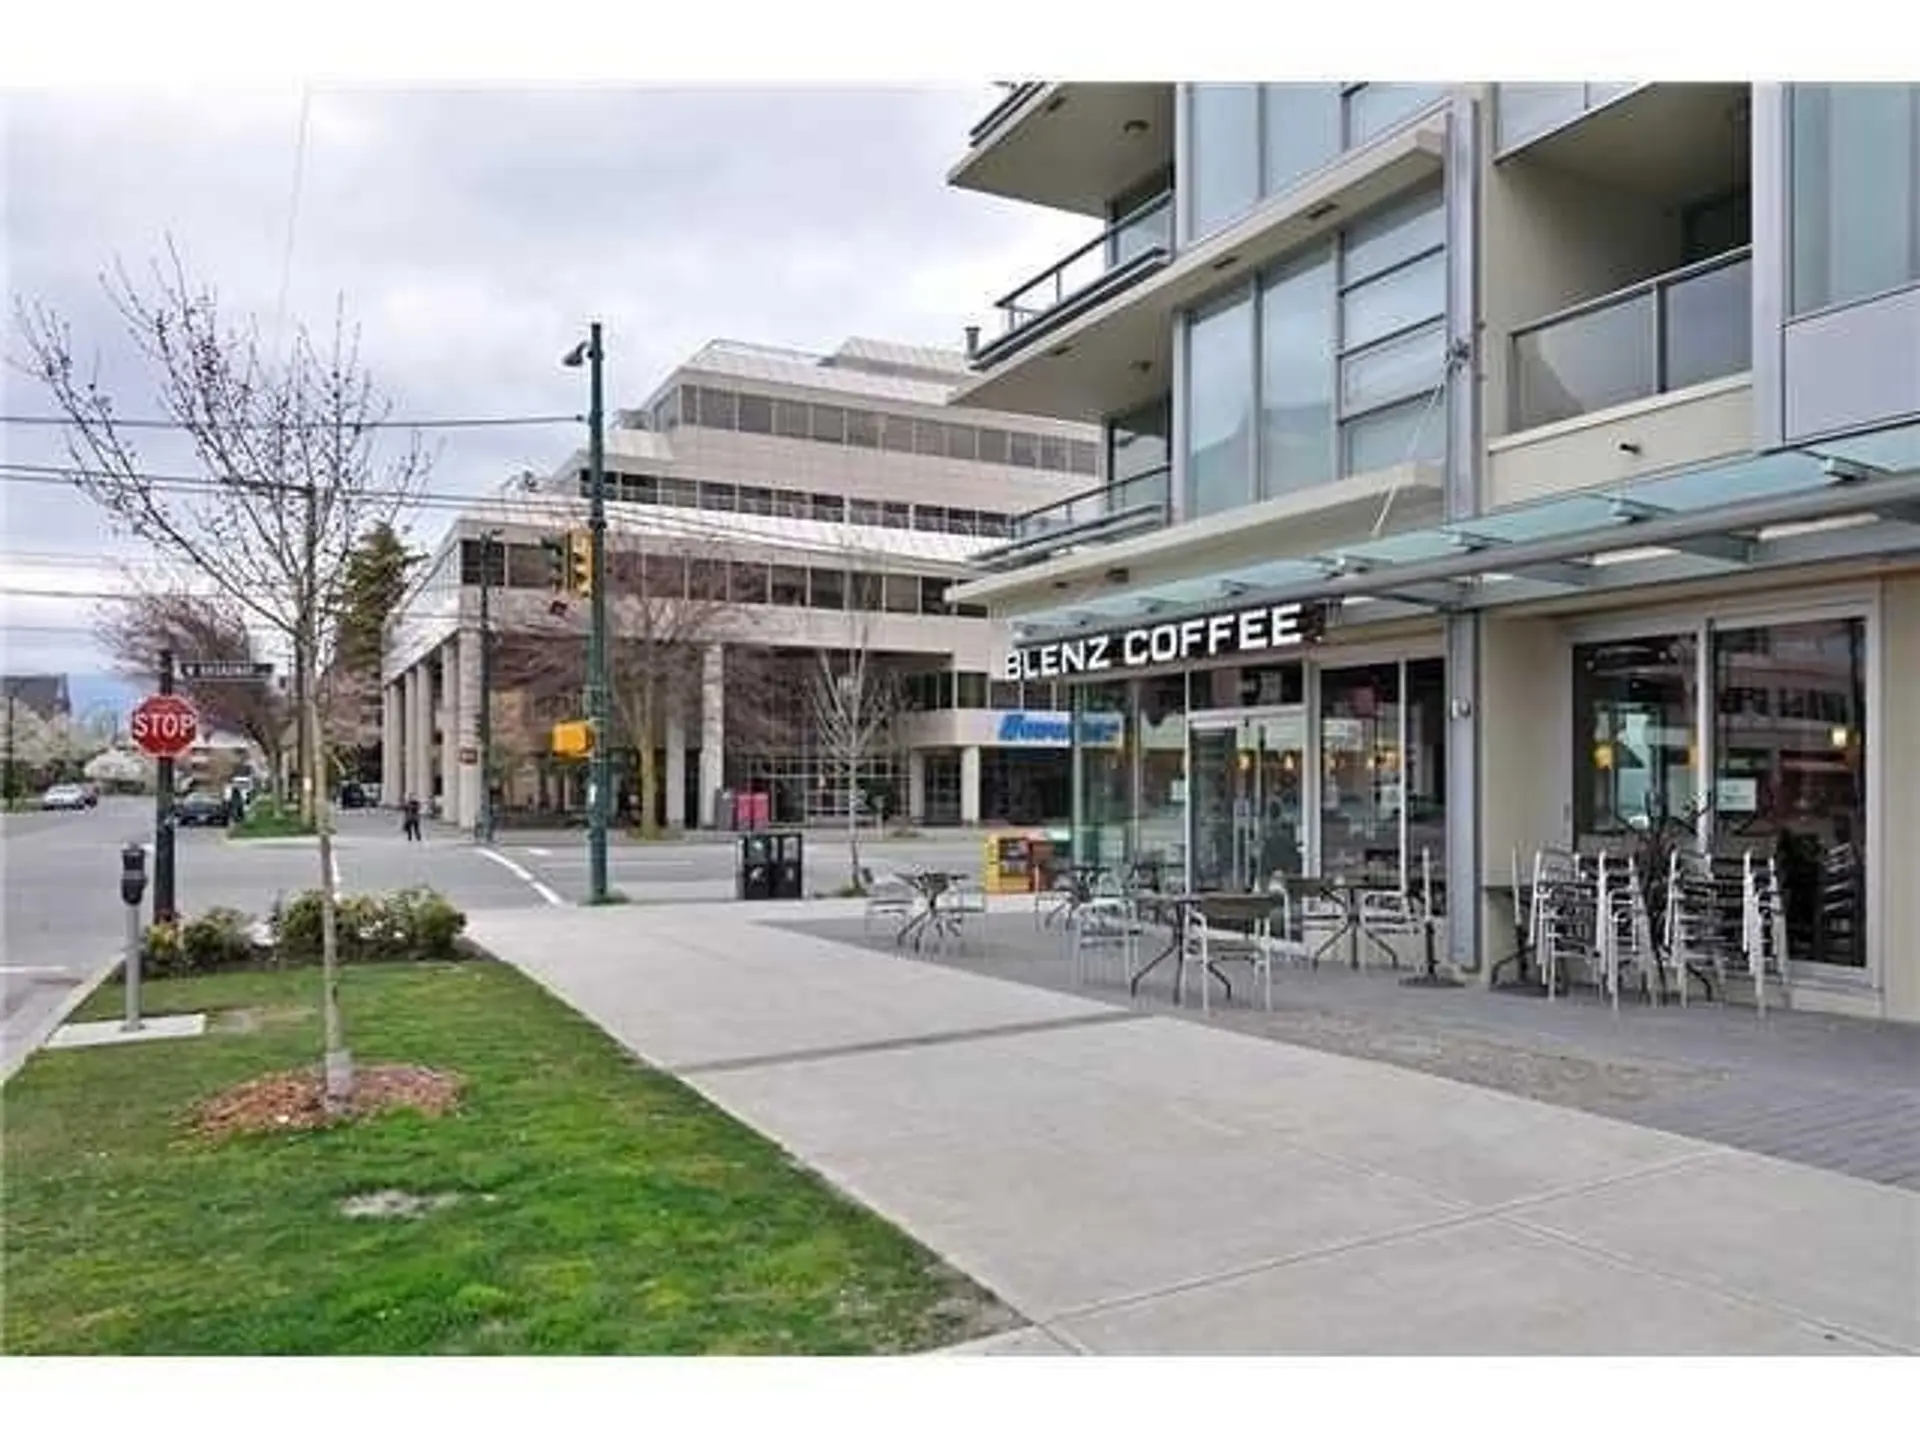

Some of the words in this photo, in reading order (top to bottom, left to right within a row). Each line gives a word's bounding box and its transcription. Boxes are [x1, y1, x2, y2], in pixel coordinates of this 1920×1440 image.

[1005, 635, 1111, 680] BLENZ
[1123, 603, 1303, 665] COFFEE
[132, 712, 196, 739] STOP
